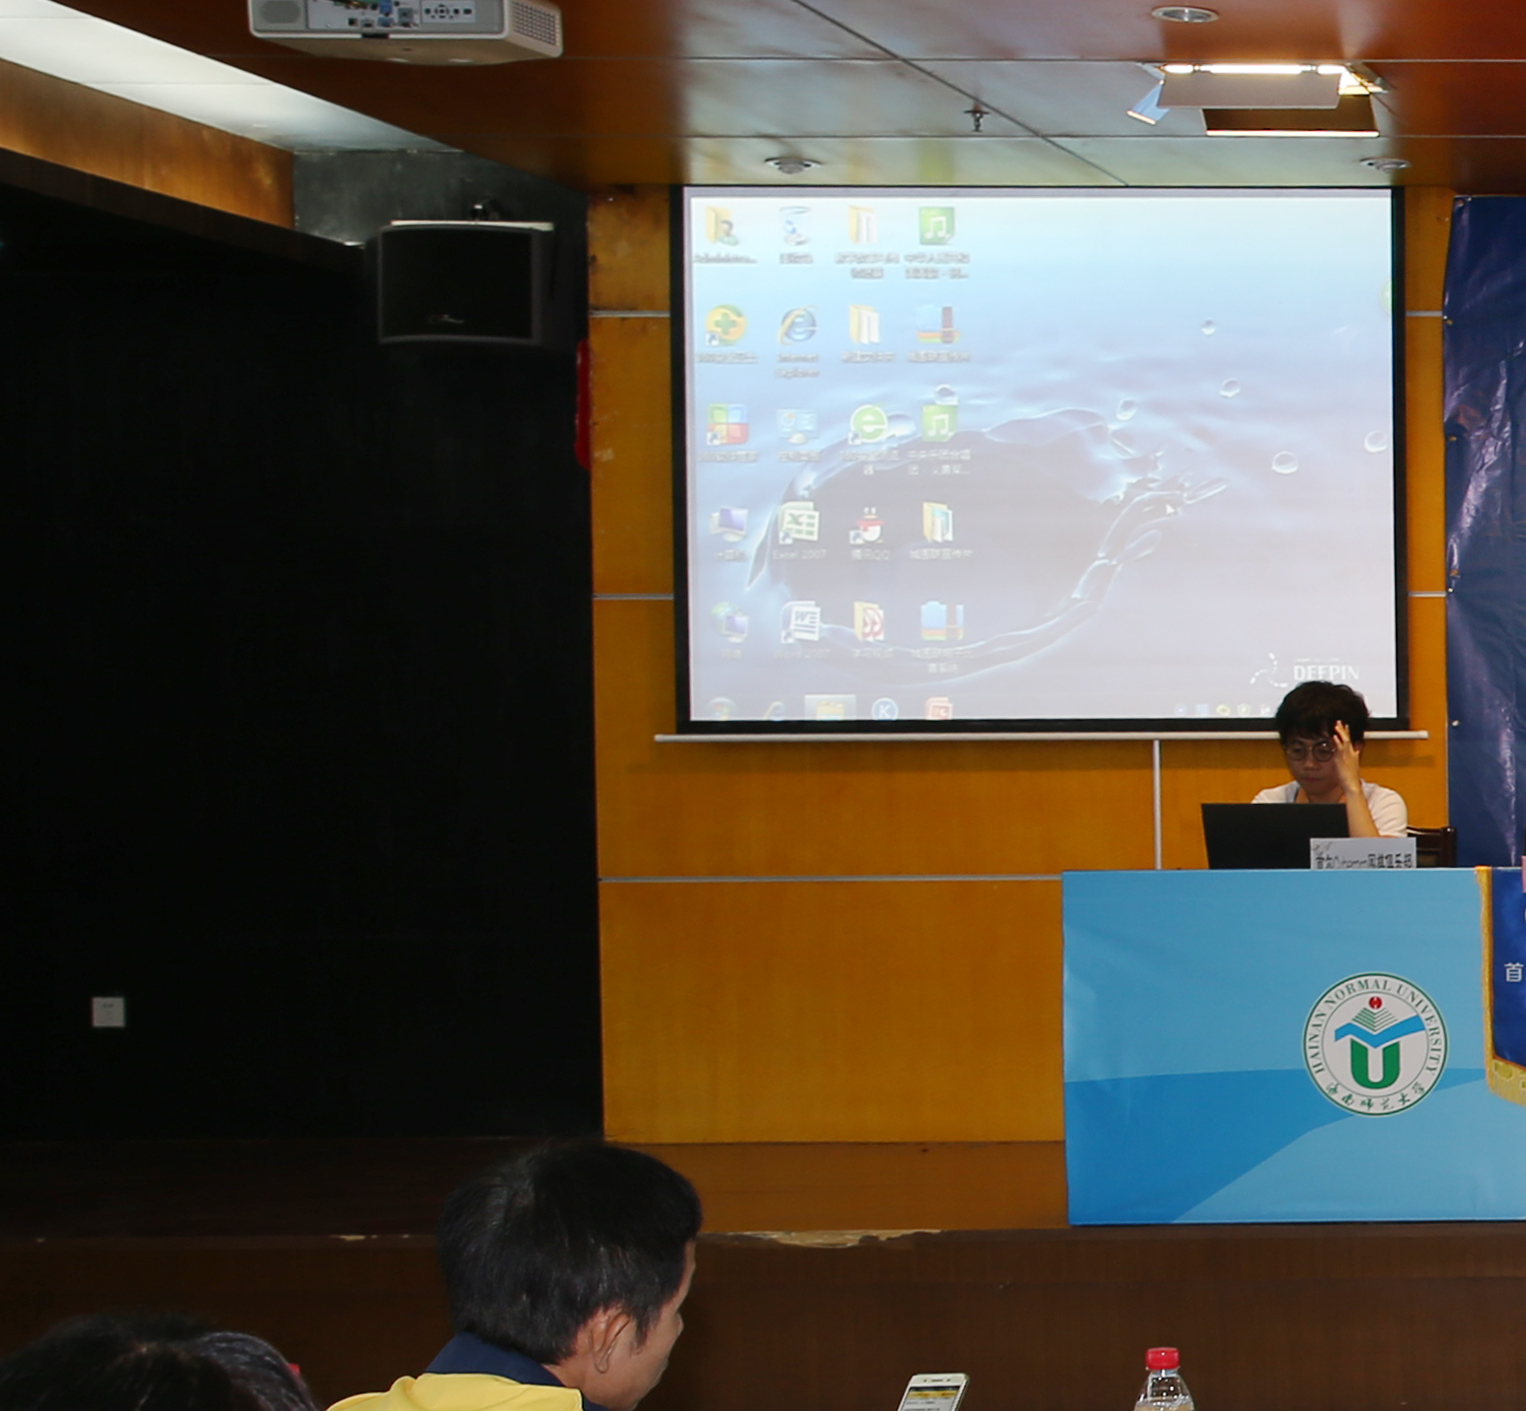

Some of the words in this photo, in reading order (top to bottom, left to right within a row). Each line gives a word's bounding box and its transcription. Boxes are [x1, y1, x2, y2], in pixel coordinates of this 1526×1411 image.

[1294, 664, 1360, 681] DEEPIN
[1307, 1011, 1325, 1074] HAINAN
[1324, 979, 1392, 1009] NORMAL
[1396, 982, 1442, 1075] UNIVERSITY
